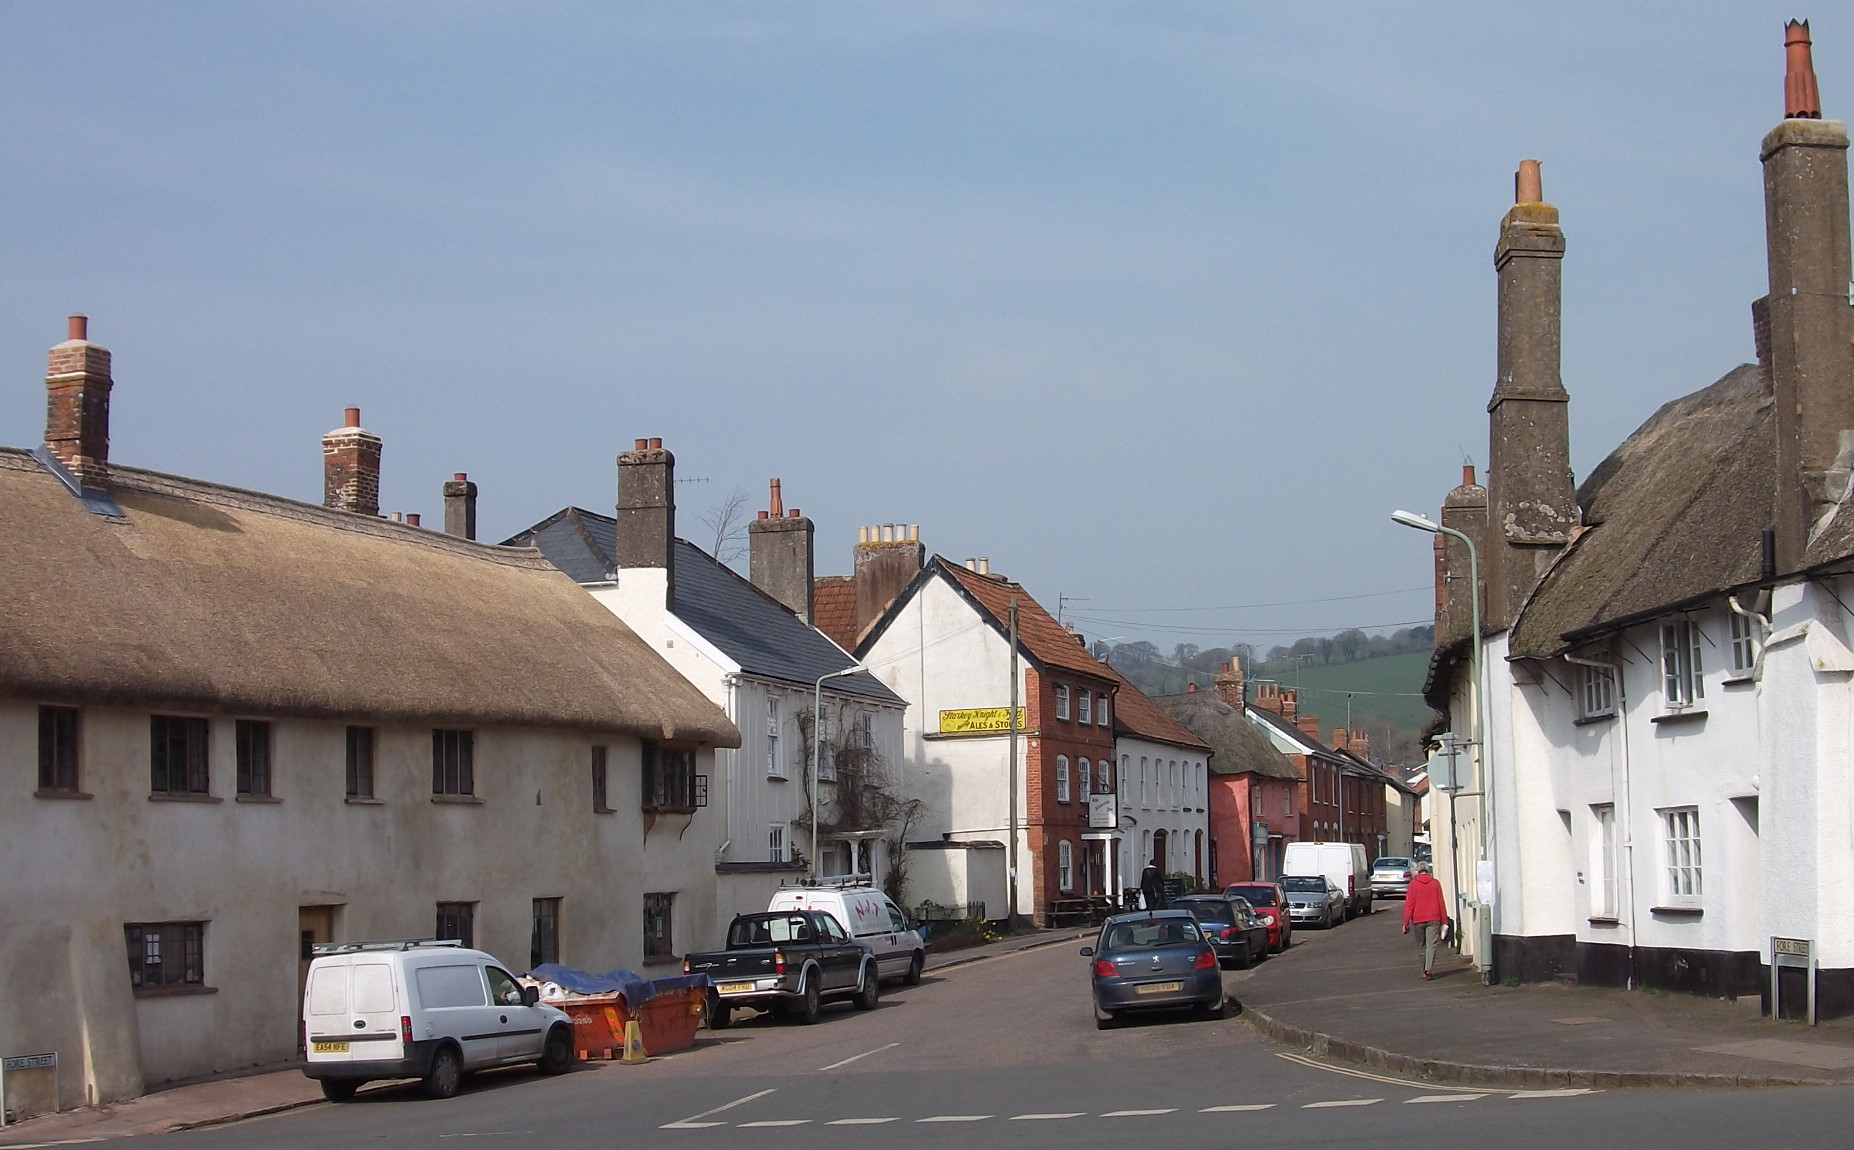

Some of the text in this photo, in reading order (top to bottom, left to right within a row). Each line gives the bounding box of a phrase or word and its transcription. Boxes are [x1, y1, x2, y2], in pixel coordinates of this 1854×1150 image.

[972, 709, 998, 721] Knight
[970, 721, 988, 730] ALES
[1776, 940, 1791, 952] FORE
[316, 1043, 332, 1051] EA54
[7, 1055, 53, 1069] FORE STREET
